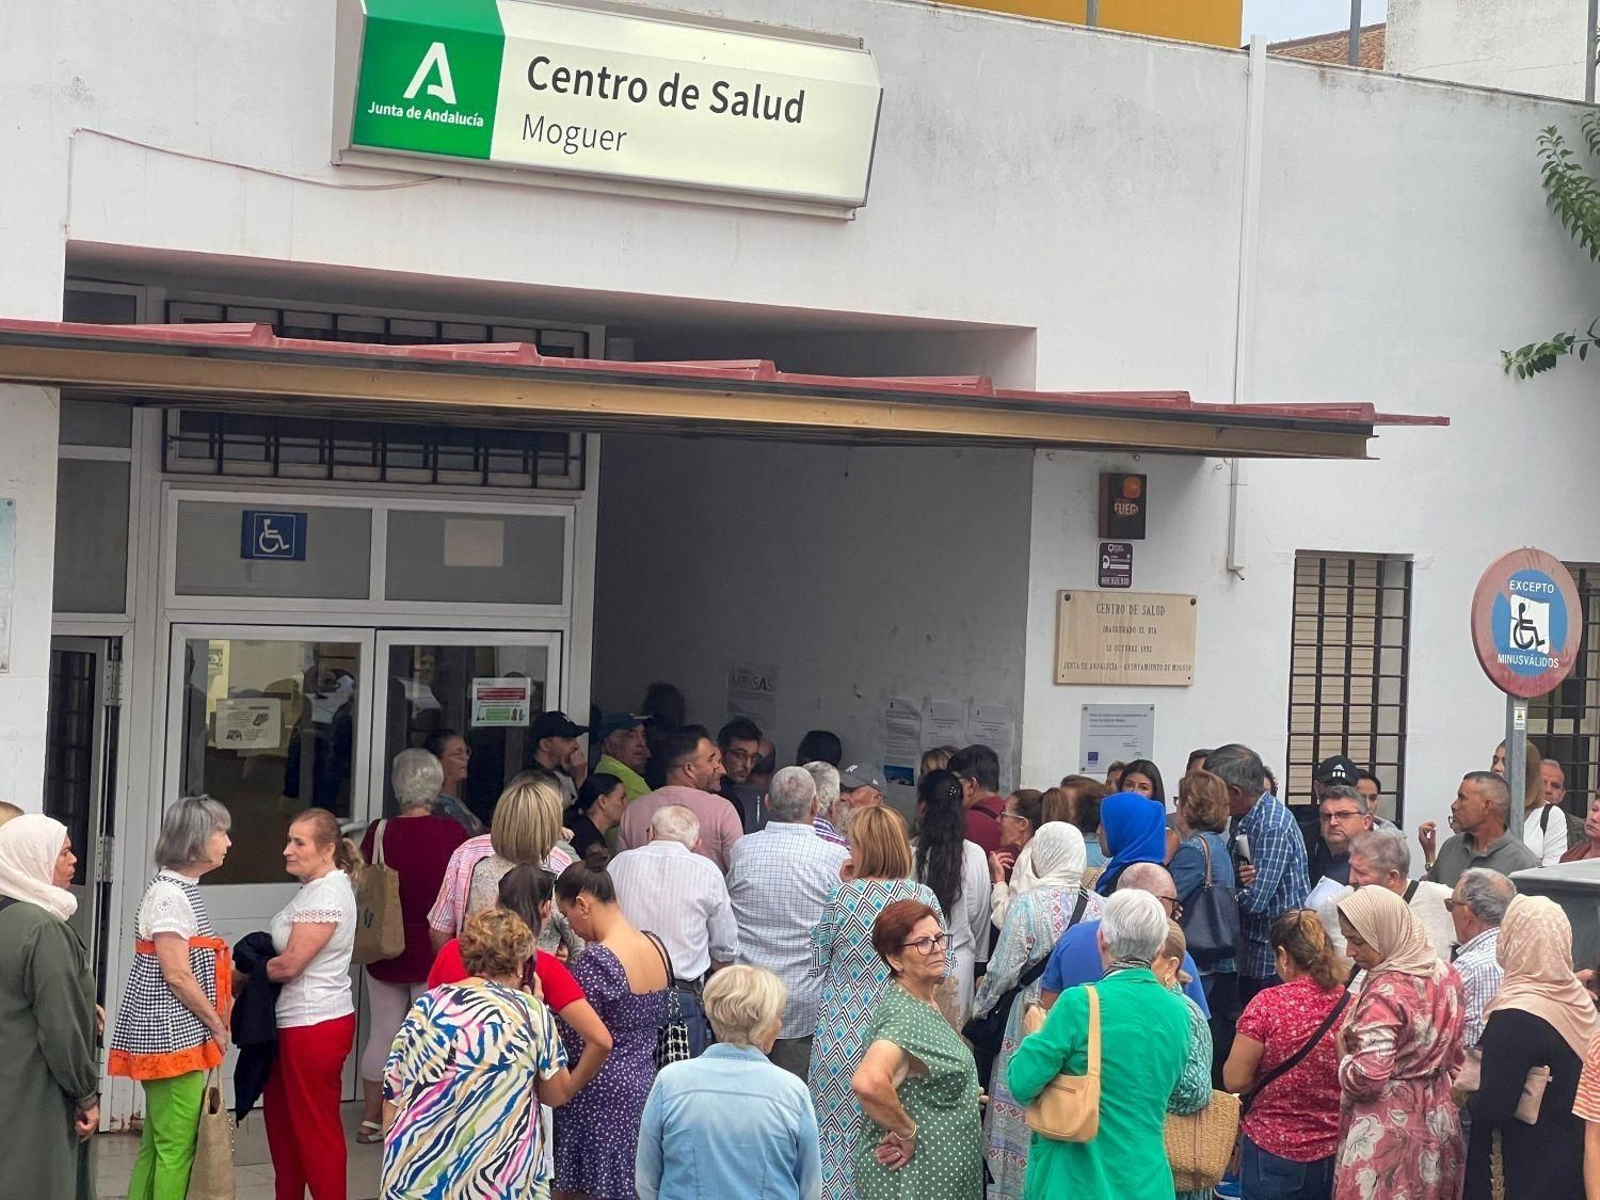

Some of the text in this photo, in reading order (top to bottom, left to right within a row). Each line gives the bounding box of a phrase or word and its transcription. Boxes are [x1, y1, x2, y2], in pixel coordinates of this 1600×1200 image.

[527, 55, 805, 124] Centro de Salud
[368, 101, 484, 127] Junta de Andalucía
[522, 114, 628, 155] Moguer
[1509, 580, 1555, 594] EXCEPTO
[1096, 603, 1166, 616] CENTRO DE SALUD
[1497, 653, 1560, 669] MINUSVÁLIDOS
